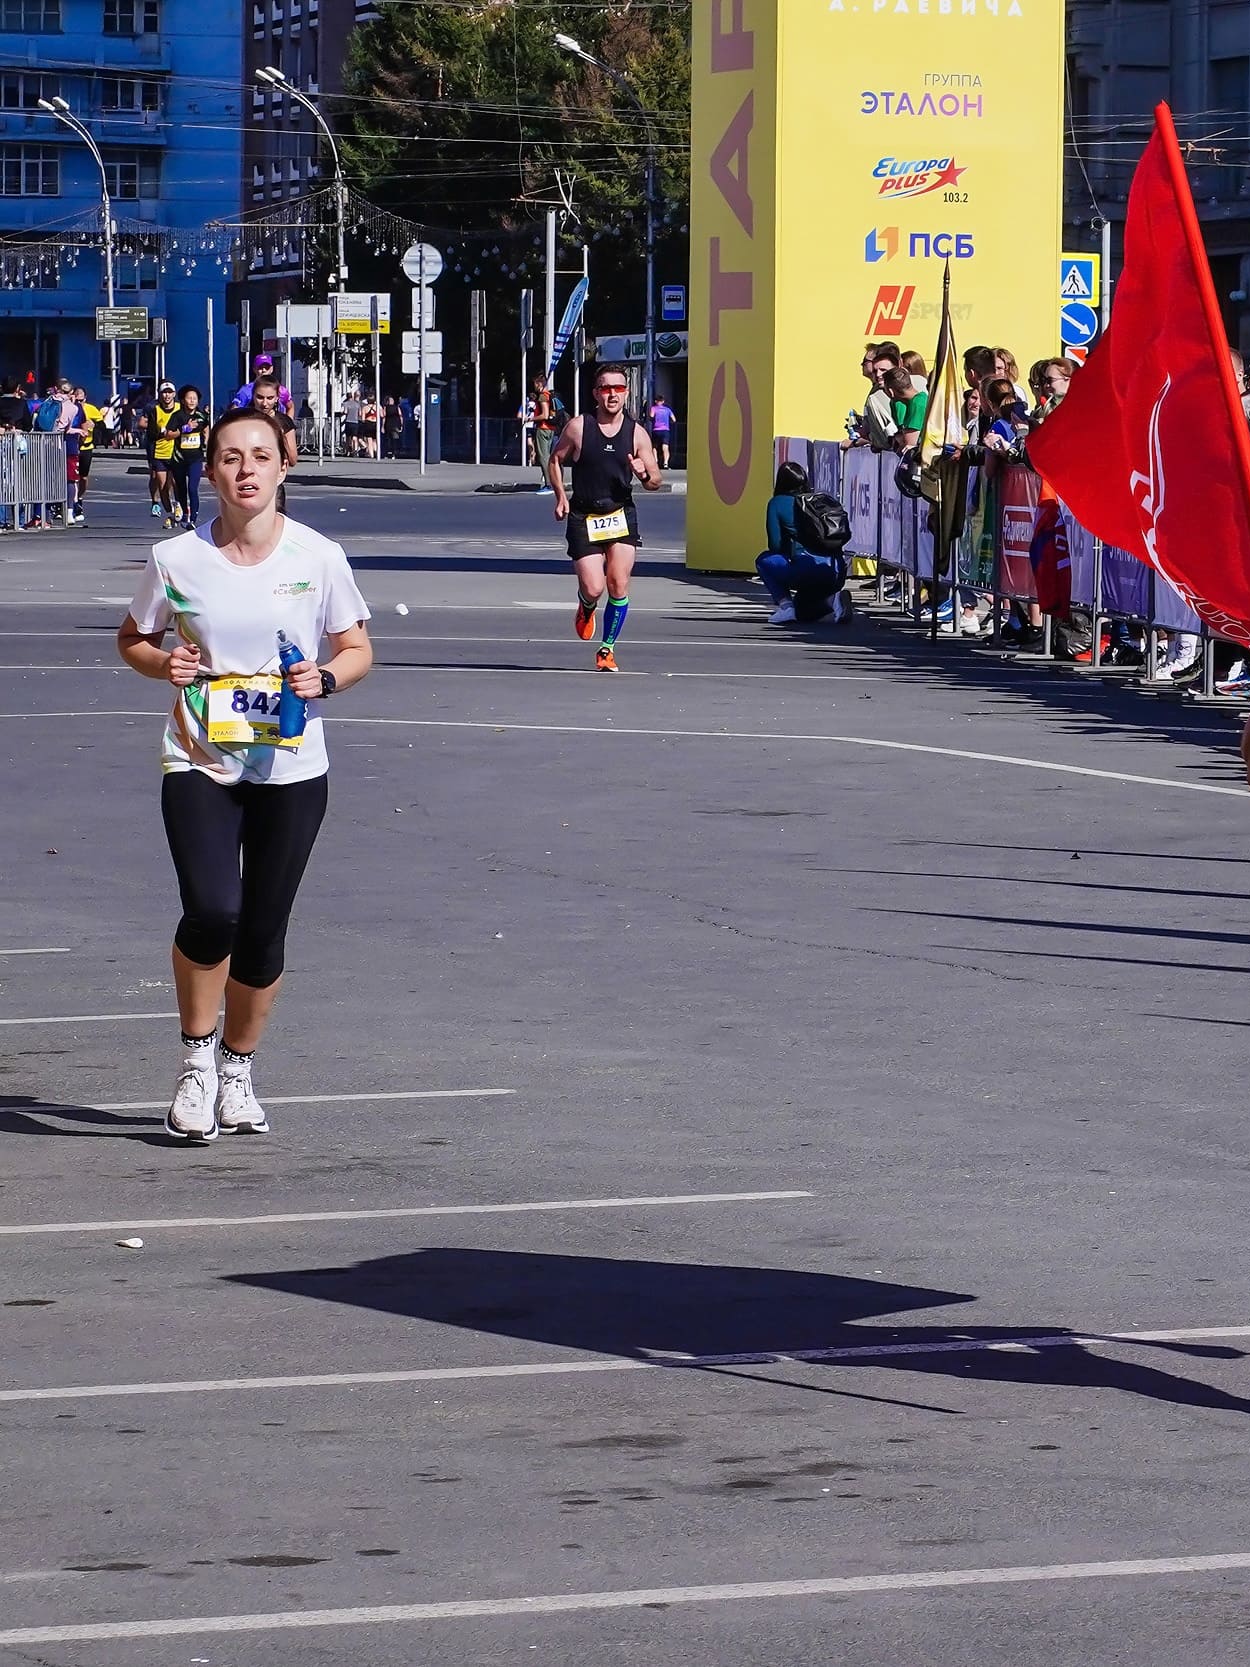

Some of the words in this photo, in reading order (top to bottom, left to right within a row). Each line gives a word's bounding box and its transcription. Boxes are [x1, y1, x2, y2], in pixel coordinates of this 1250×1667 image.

[924, 73, 983, 88] ГРУППА
[860, 91, 983, 118] ЭТАЛОН
[943, 192, 968, 203] 103.2
[909, 233, 975, 259] ПСБ
[909, 302, 973, 320] SPRT
[592, 516, 620, 530] 1275
